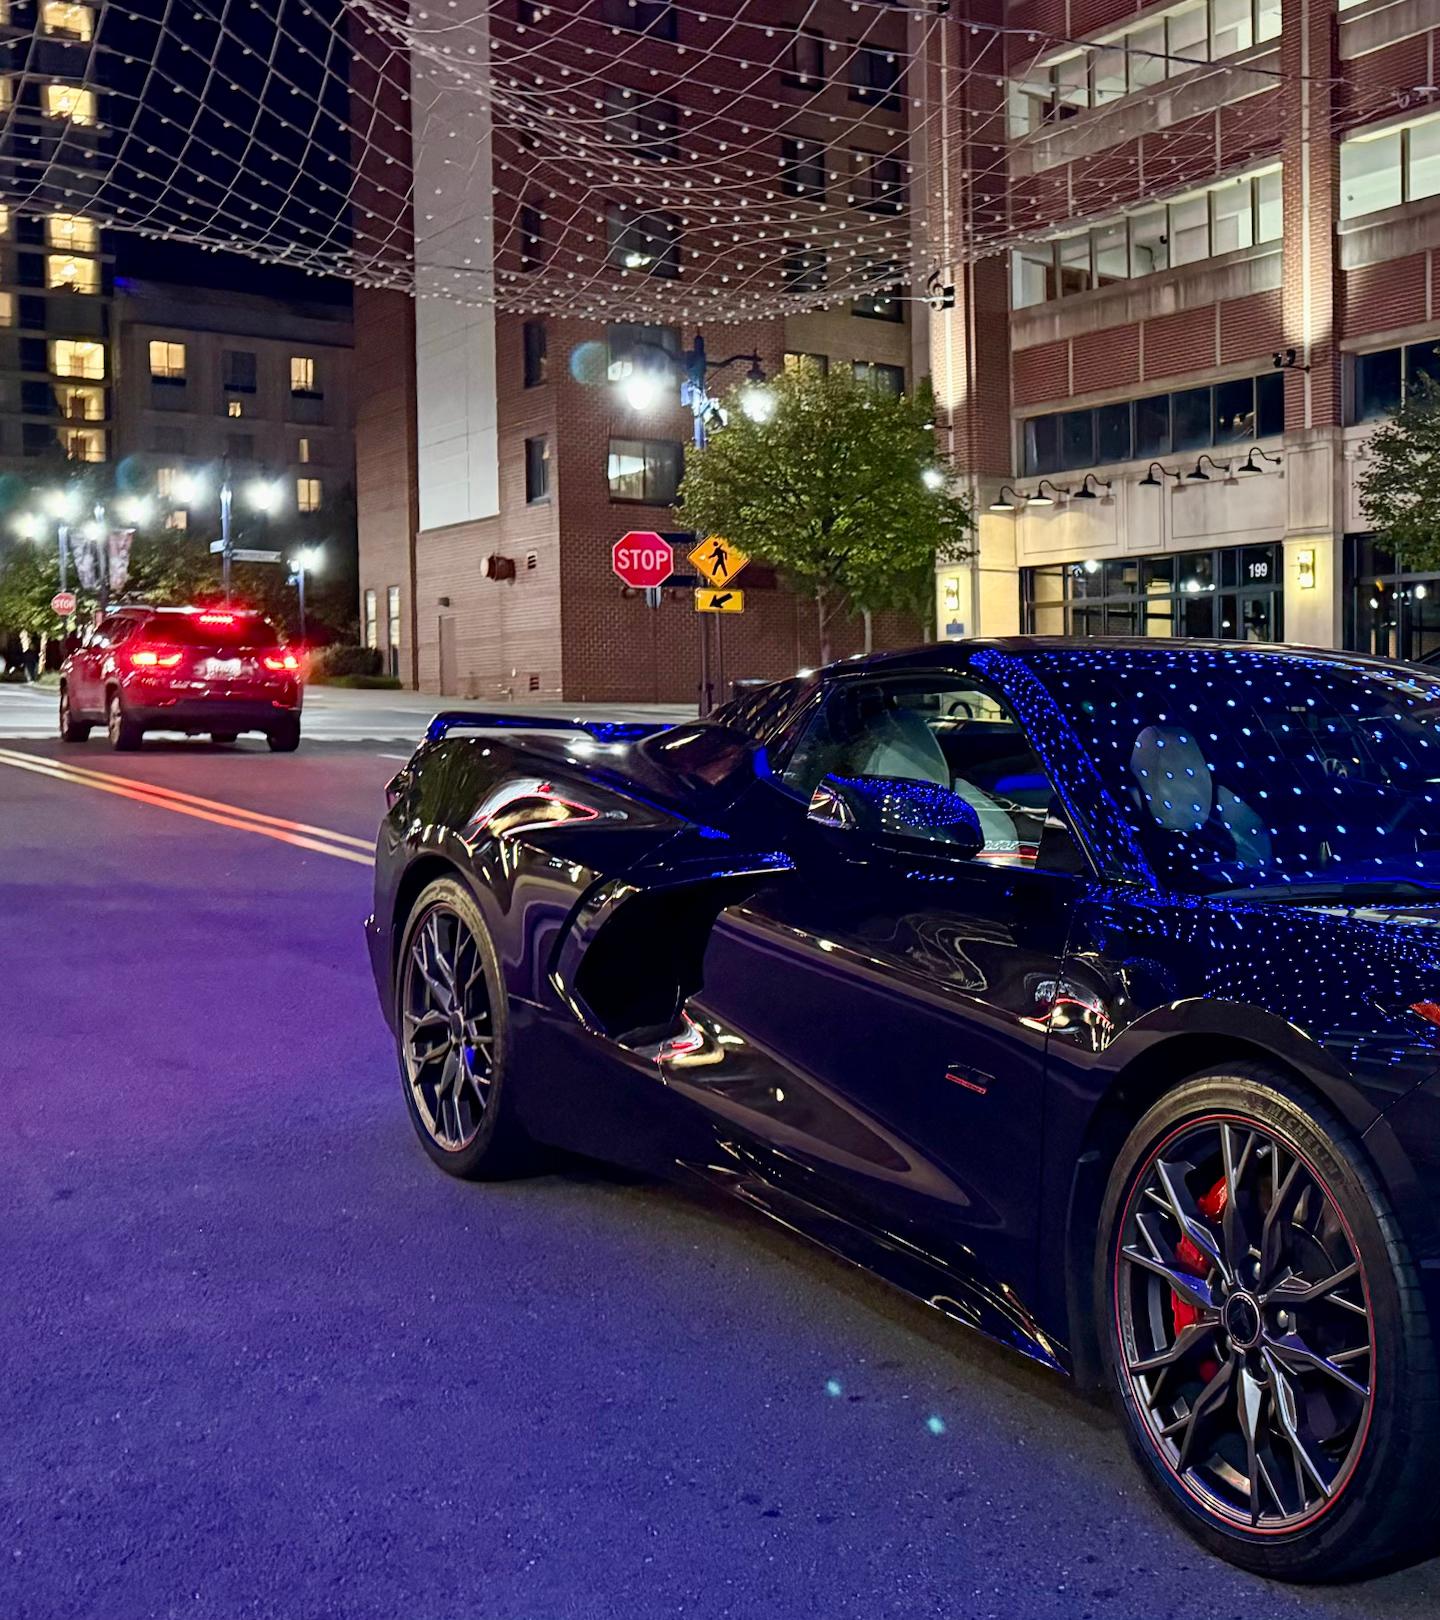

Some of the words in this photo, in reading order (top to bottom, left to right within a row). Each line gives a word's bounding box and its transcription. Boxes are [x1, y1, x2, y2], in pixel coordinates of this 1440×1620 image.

[617, 548, 669, 571] STOP
[1248, 562, 1268, 578] 199
[54, 598, 75, 609] STOP
